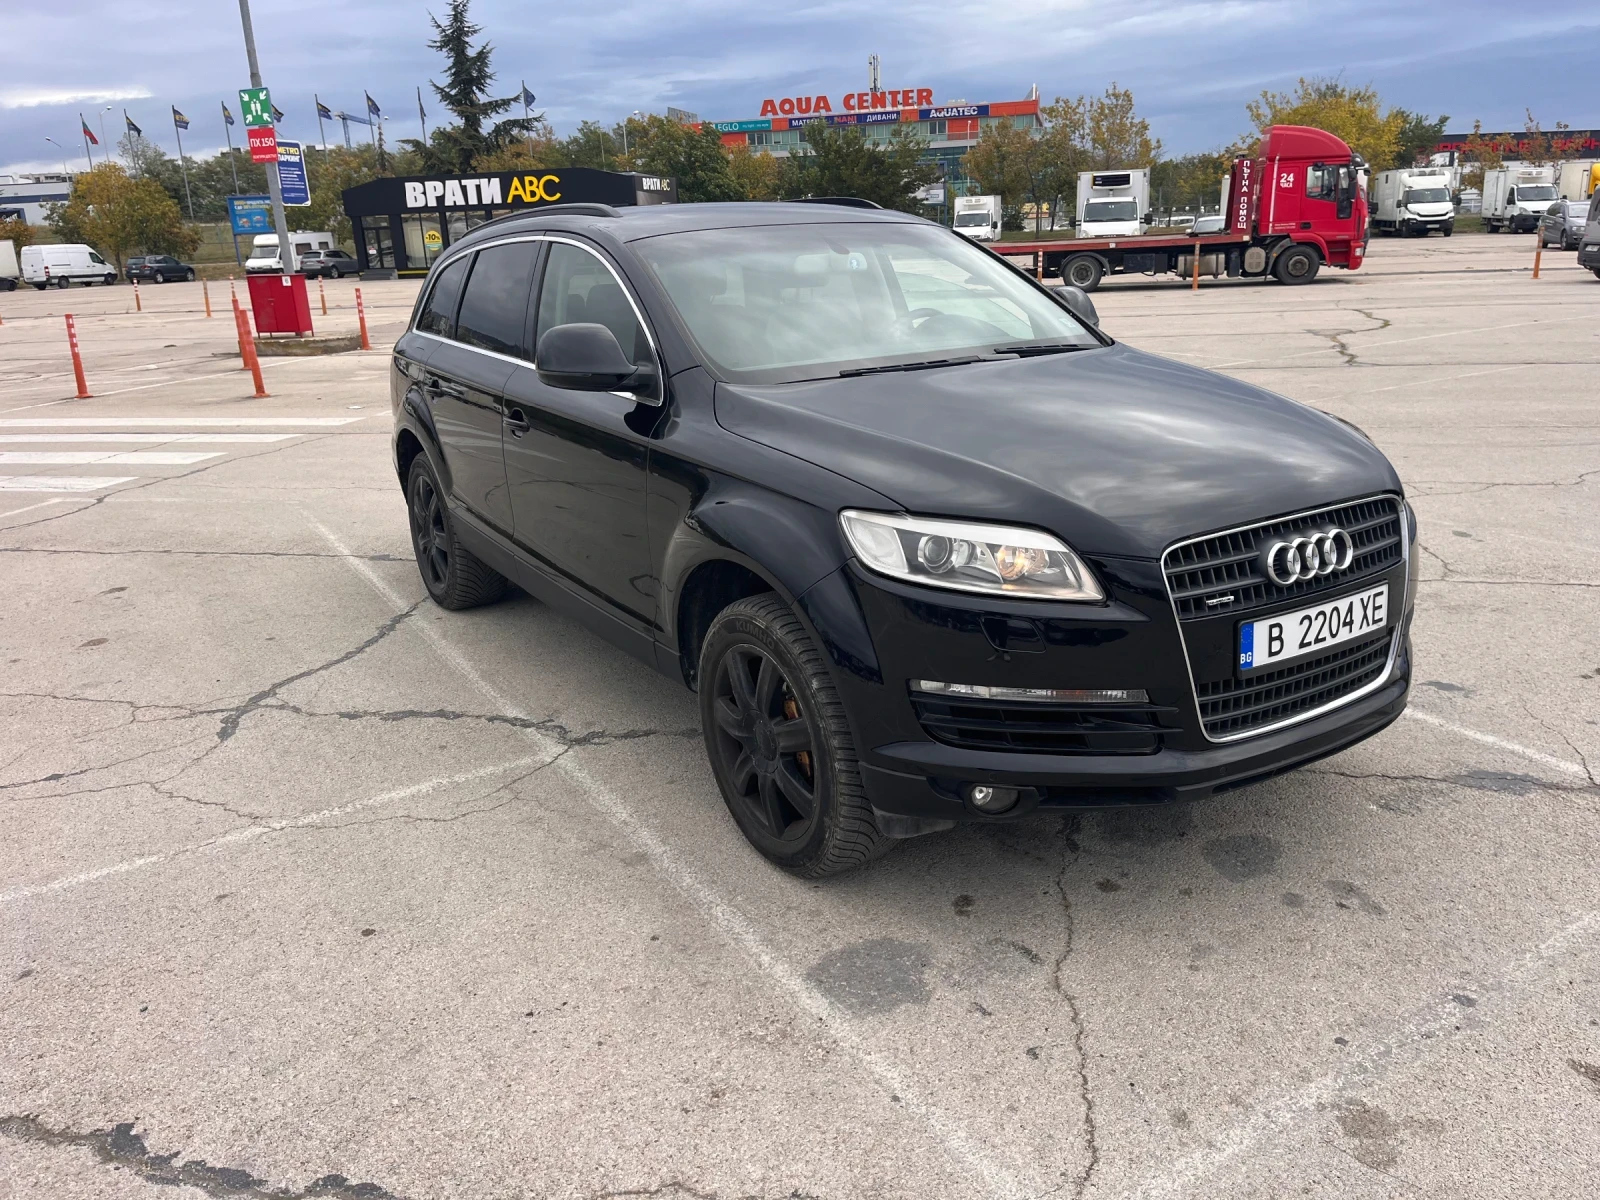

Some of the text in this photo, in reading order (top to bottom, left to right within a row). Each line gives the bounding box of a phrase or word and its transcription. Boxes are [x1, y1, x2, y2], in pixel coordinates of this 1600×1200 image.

[760, 88, 934, 117] AQUA CENTER
[866, 113, 897, 123] ДИВАНИ
[929, 106, 978, 118] AQUATEC
[717, 122, 739, 132] EGLO
[261, 137, 275, 147] 150
[277, 147, 300, 155] METRO
[642, 177, 660, 191] ВРАТИ
[1279, 173, 1295, 183] 24
[404, 177, 502, 208] ВРАТИ
[1237, 160, 1251, 229] ПЪТНА ПОМОЩ
[1267, 590, 1385, 658] B 2204 XE
[736, 620, 775, 650] KUMHO
[1240, 652, 1253, 664] BG
